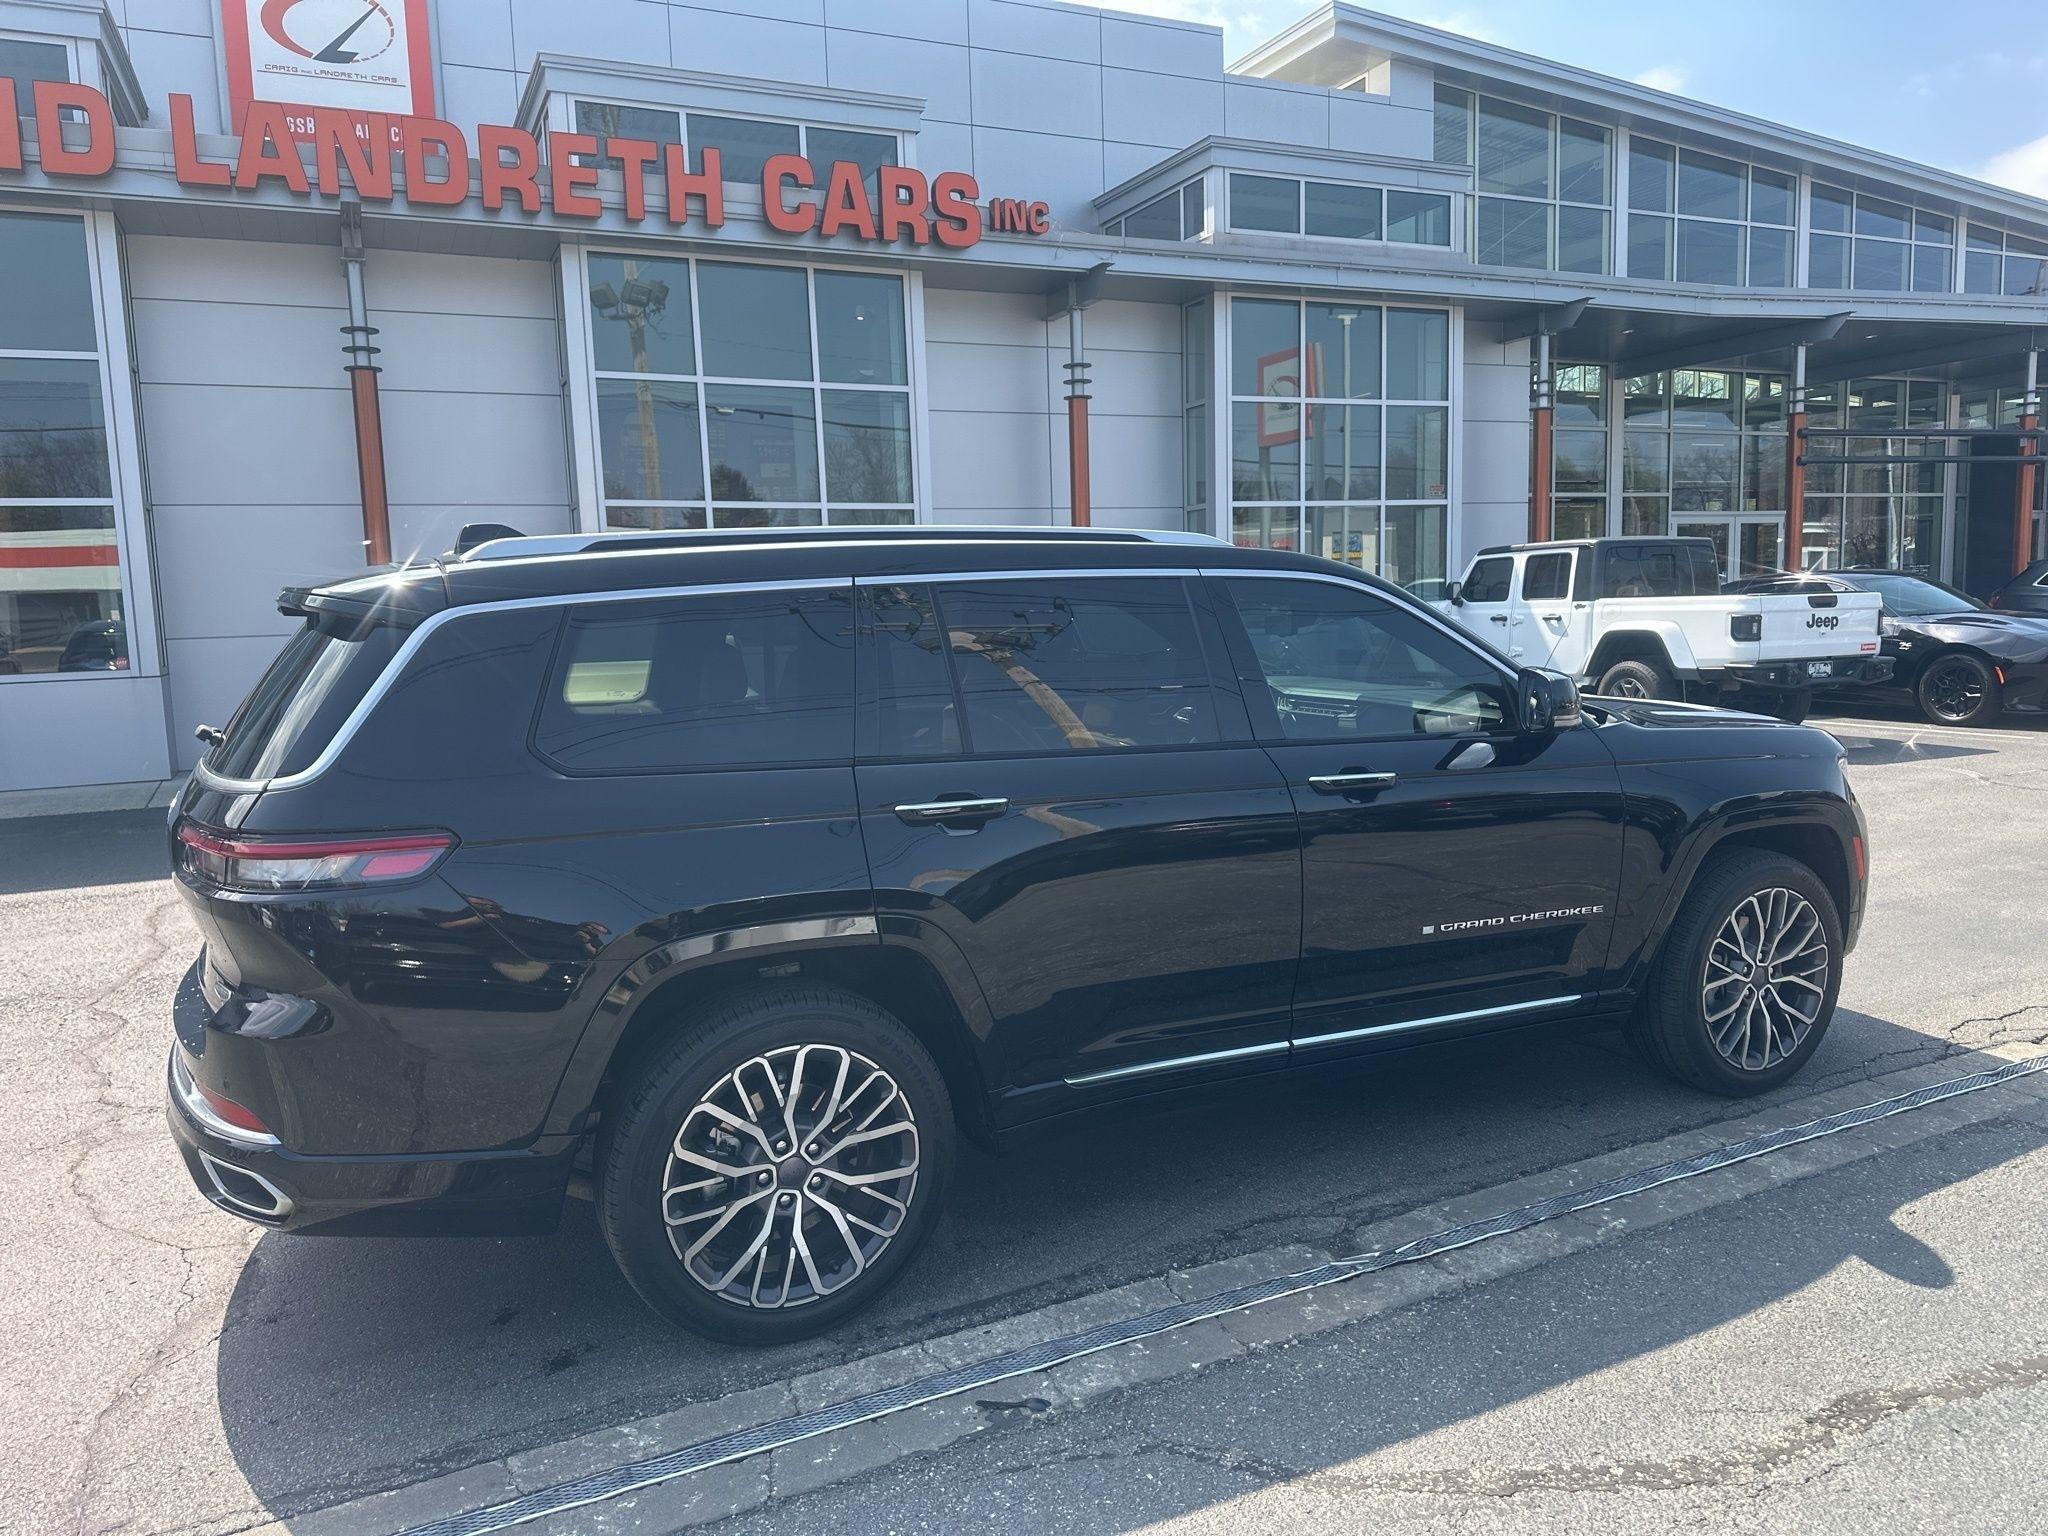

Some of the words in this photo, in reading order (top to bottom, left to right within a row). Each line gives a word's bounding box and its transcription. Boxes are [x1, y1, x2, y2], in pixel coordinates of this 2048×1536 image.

[264, 63, 298, 73] CRAIG
[313, 69, 368, 81] LANDRETH
[371, 75, 398, 83] CARS
[168, 93, 724, 228] LANDRETH
[761, 153, 982, 248] CARS
[989, 197, 1050, 235] INC
[1806, 613, 1839, 630] Jeep
[1440, 916, 1505, 933] GRAND
[1509, 905, 1604, 923] CHEROKEE
